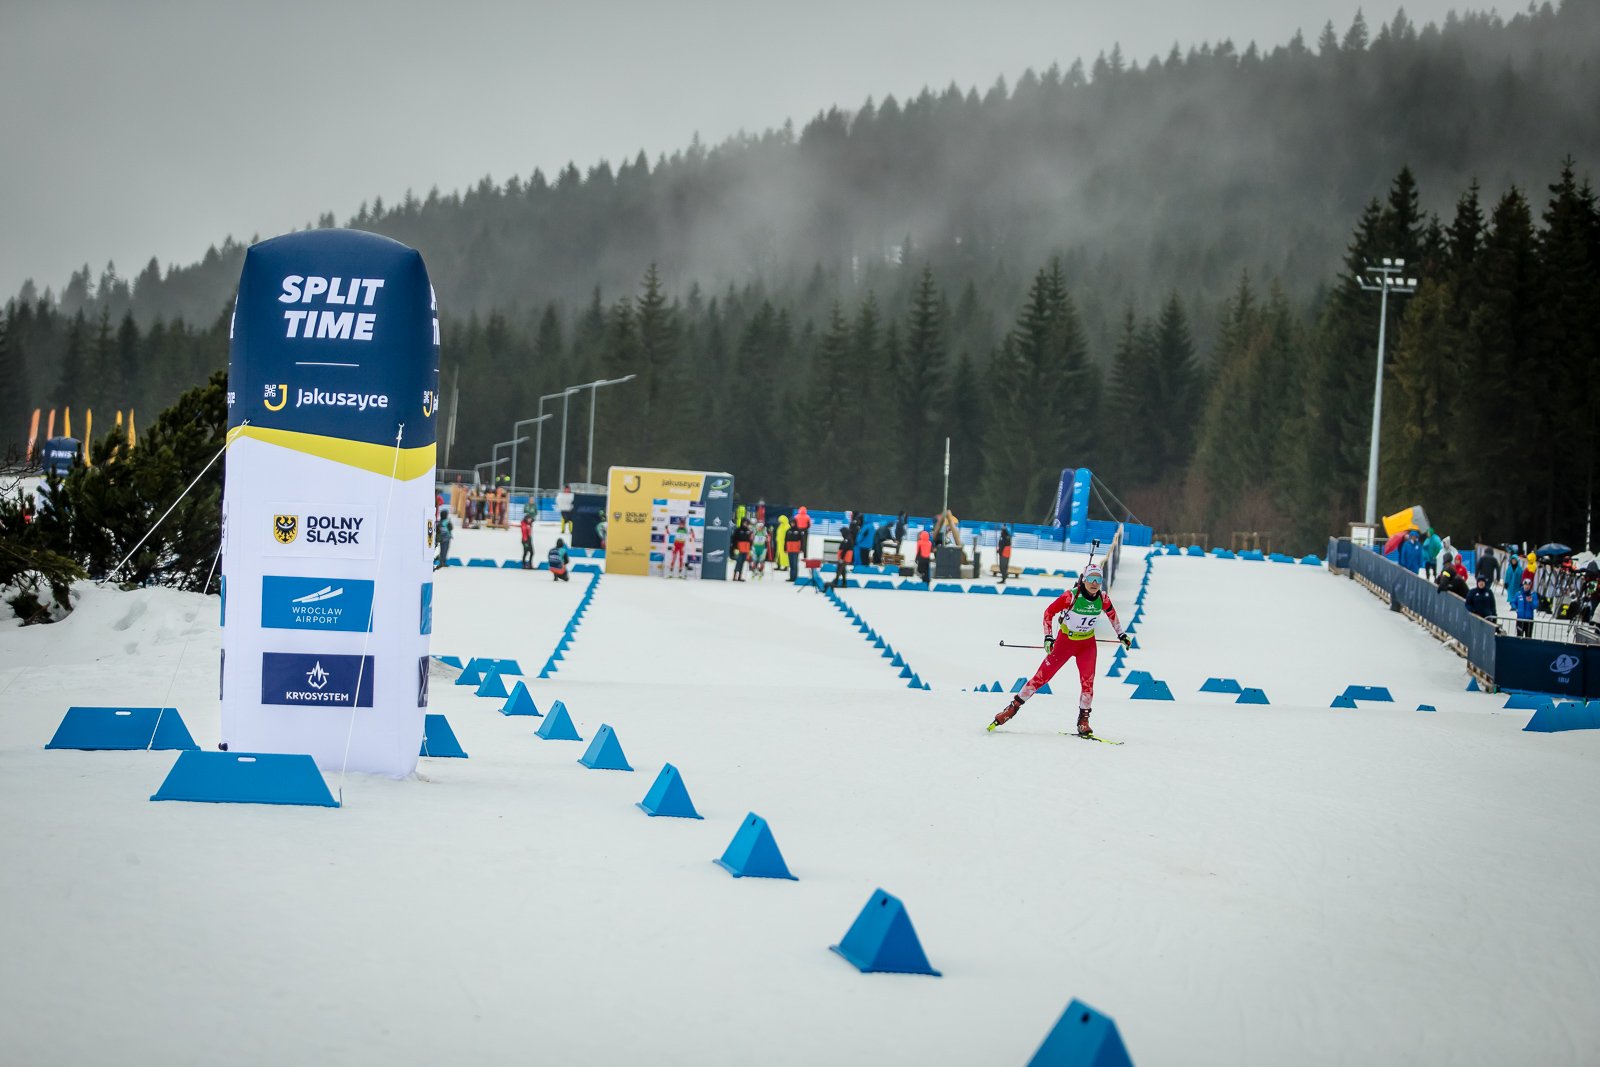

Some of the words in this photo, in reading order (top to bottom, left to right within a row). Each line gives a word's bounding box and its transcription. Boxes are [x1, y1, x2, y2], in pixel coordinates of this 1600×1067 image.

[278, 274, 385, 306] SPLIT
[284, 310, 377, 341] TIME
[296, 388, 389, 411] Jakuszyce
[306, 516, 364, 530] DOLNY
[306, 527, 359, 545] ŚLĄSK
[292, 606, 343, 615] WROCLAW
[295, 615, 339, 624] AIRPORT
[1081, 616, 1097, 626] 16
[286, 692, 349, 701] KRYOSYSTEM
